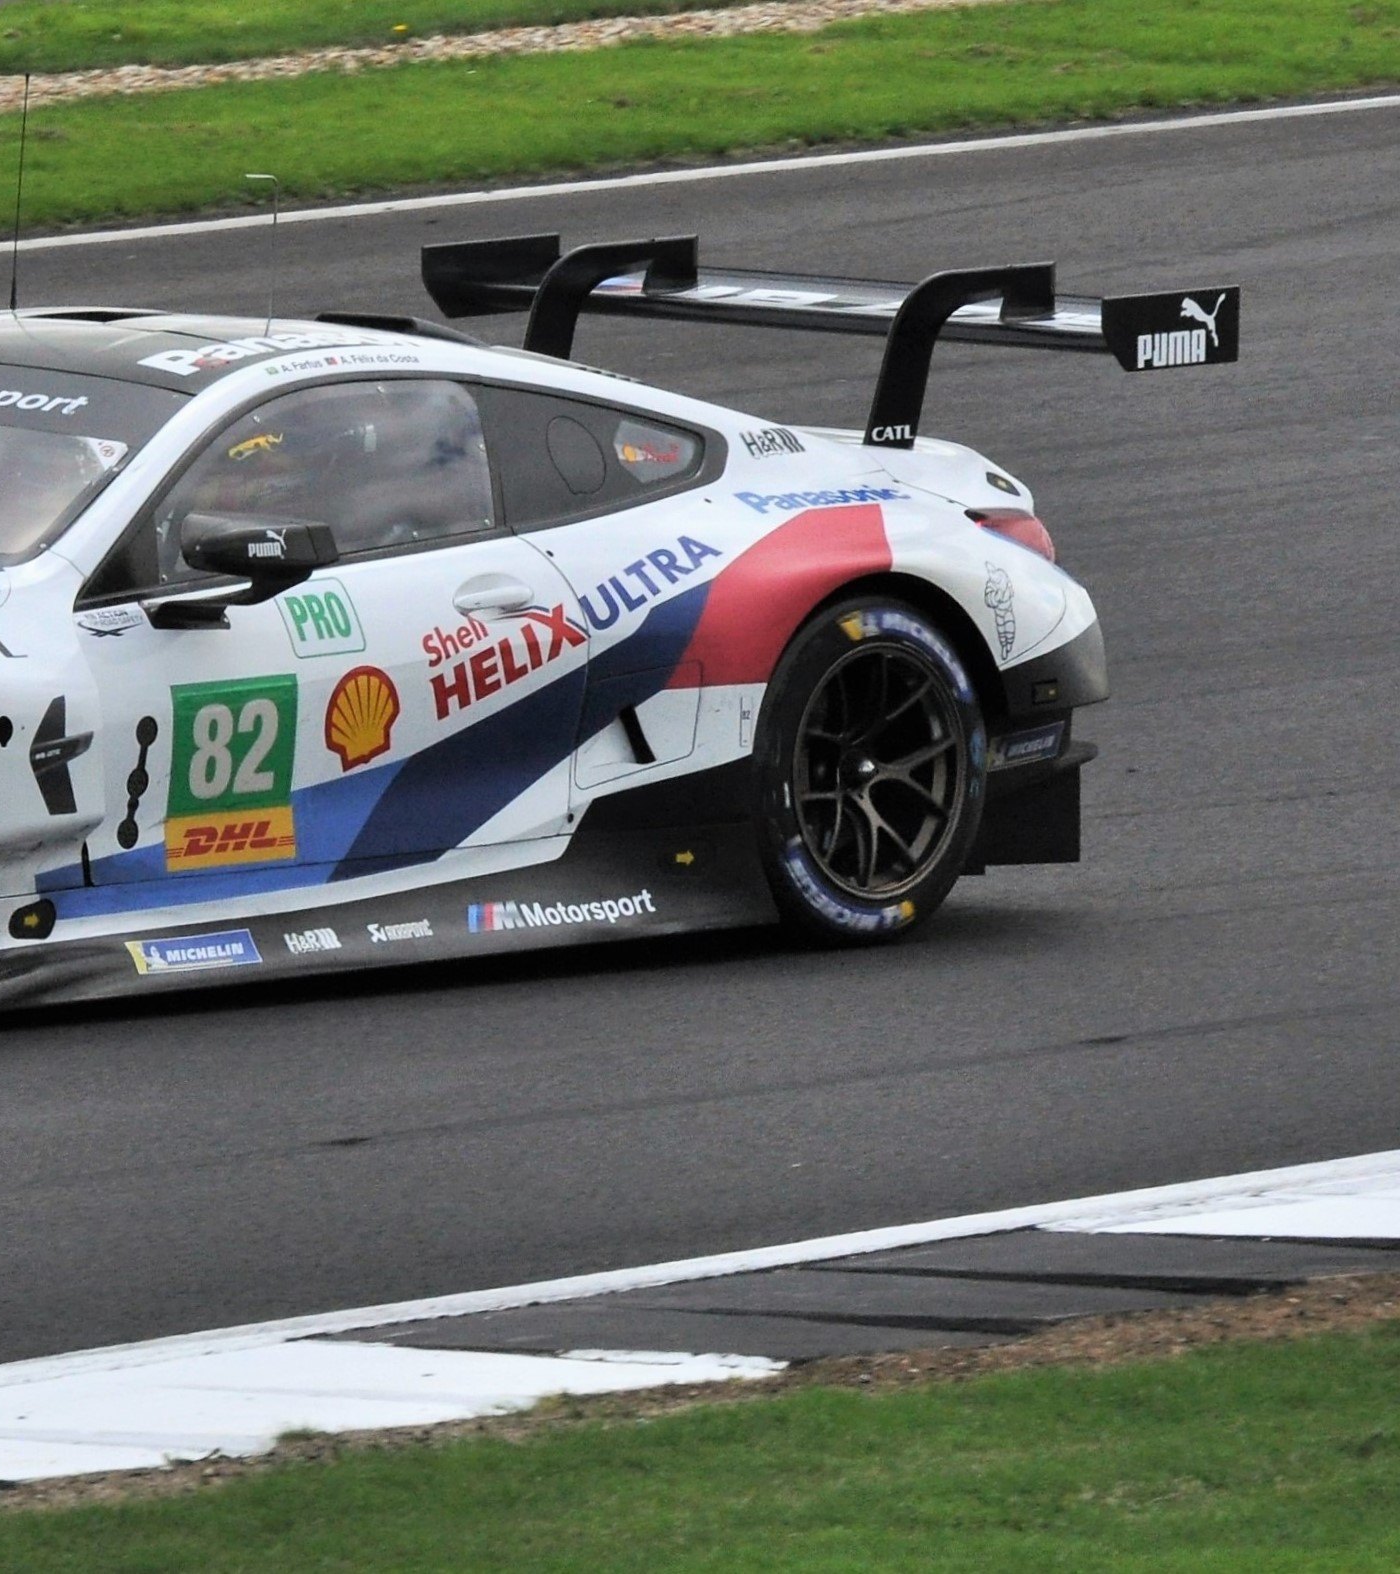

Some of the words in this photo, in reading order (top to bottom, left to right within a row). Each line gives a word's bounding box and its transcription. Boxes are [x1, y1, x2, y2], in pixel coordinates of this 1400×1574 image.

[389, 353, 420, 364] Costa
[1137, 329, 1206, 369] PUMA
[871, 424, 915, 442] CATL
[732, 484, 912, 514] Panasonic
[247, 542, 283, 559] PUMA
[284, 591, 352, 642] PRO
[429, 602, 588, 721] HELIX
[579, 535, 723, 633] ULTRA
[188, 697, 280, 801] 82
[182, 819, 278, 857] DHL
[519, 888, 657, 928] Motorsport
[165, 942, 245, 963] MICHELIN
